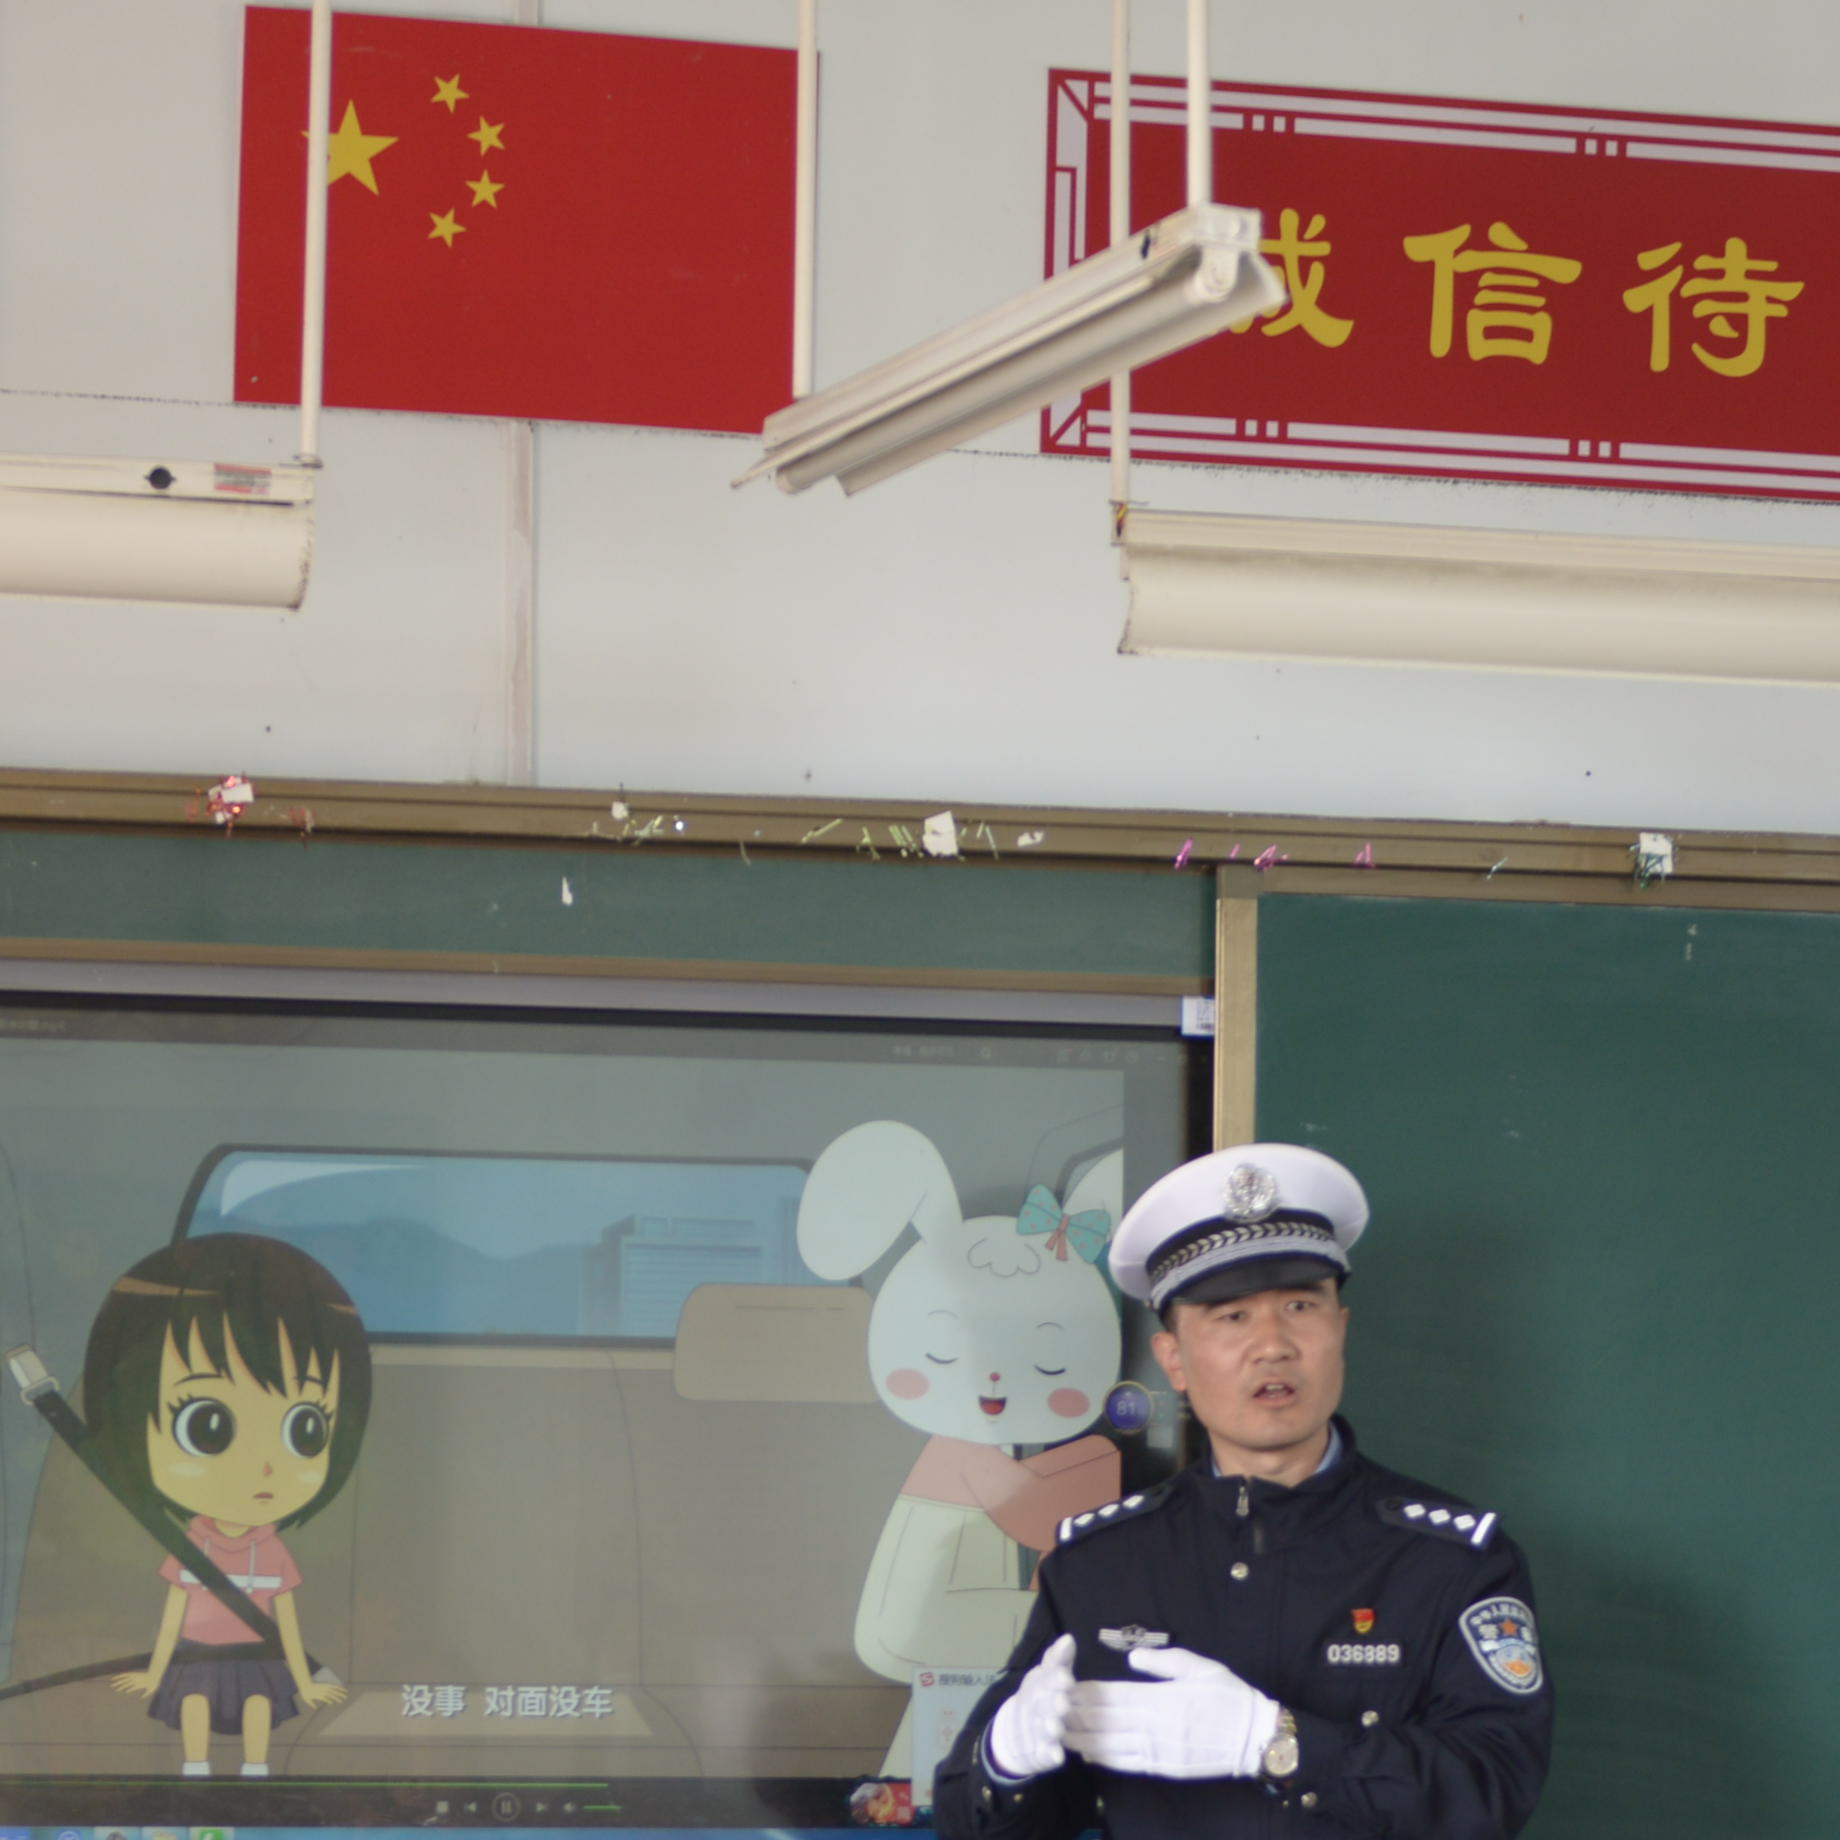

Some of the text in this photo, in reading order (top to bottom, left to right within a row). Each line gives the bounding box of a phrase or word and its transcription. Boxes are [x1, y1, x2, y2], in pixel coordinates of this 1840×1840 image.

[402, 1685, 614, 1718] 没事 对面没车
